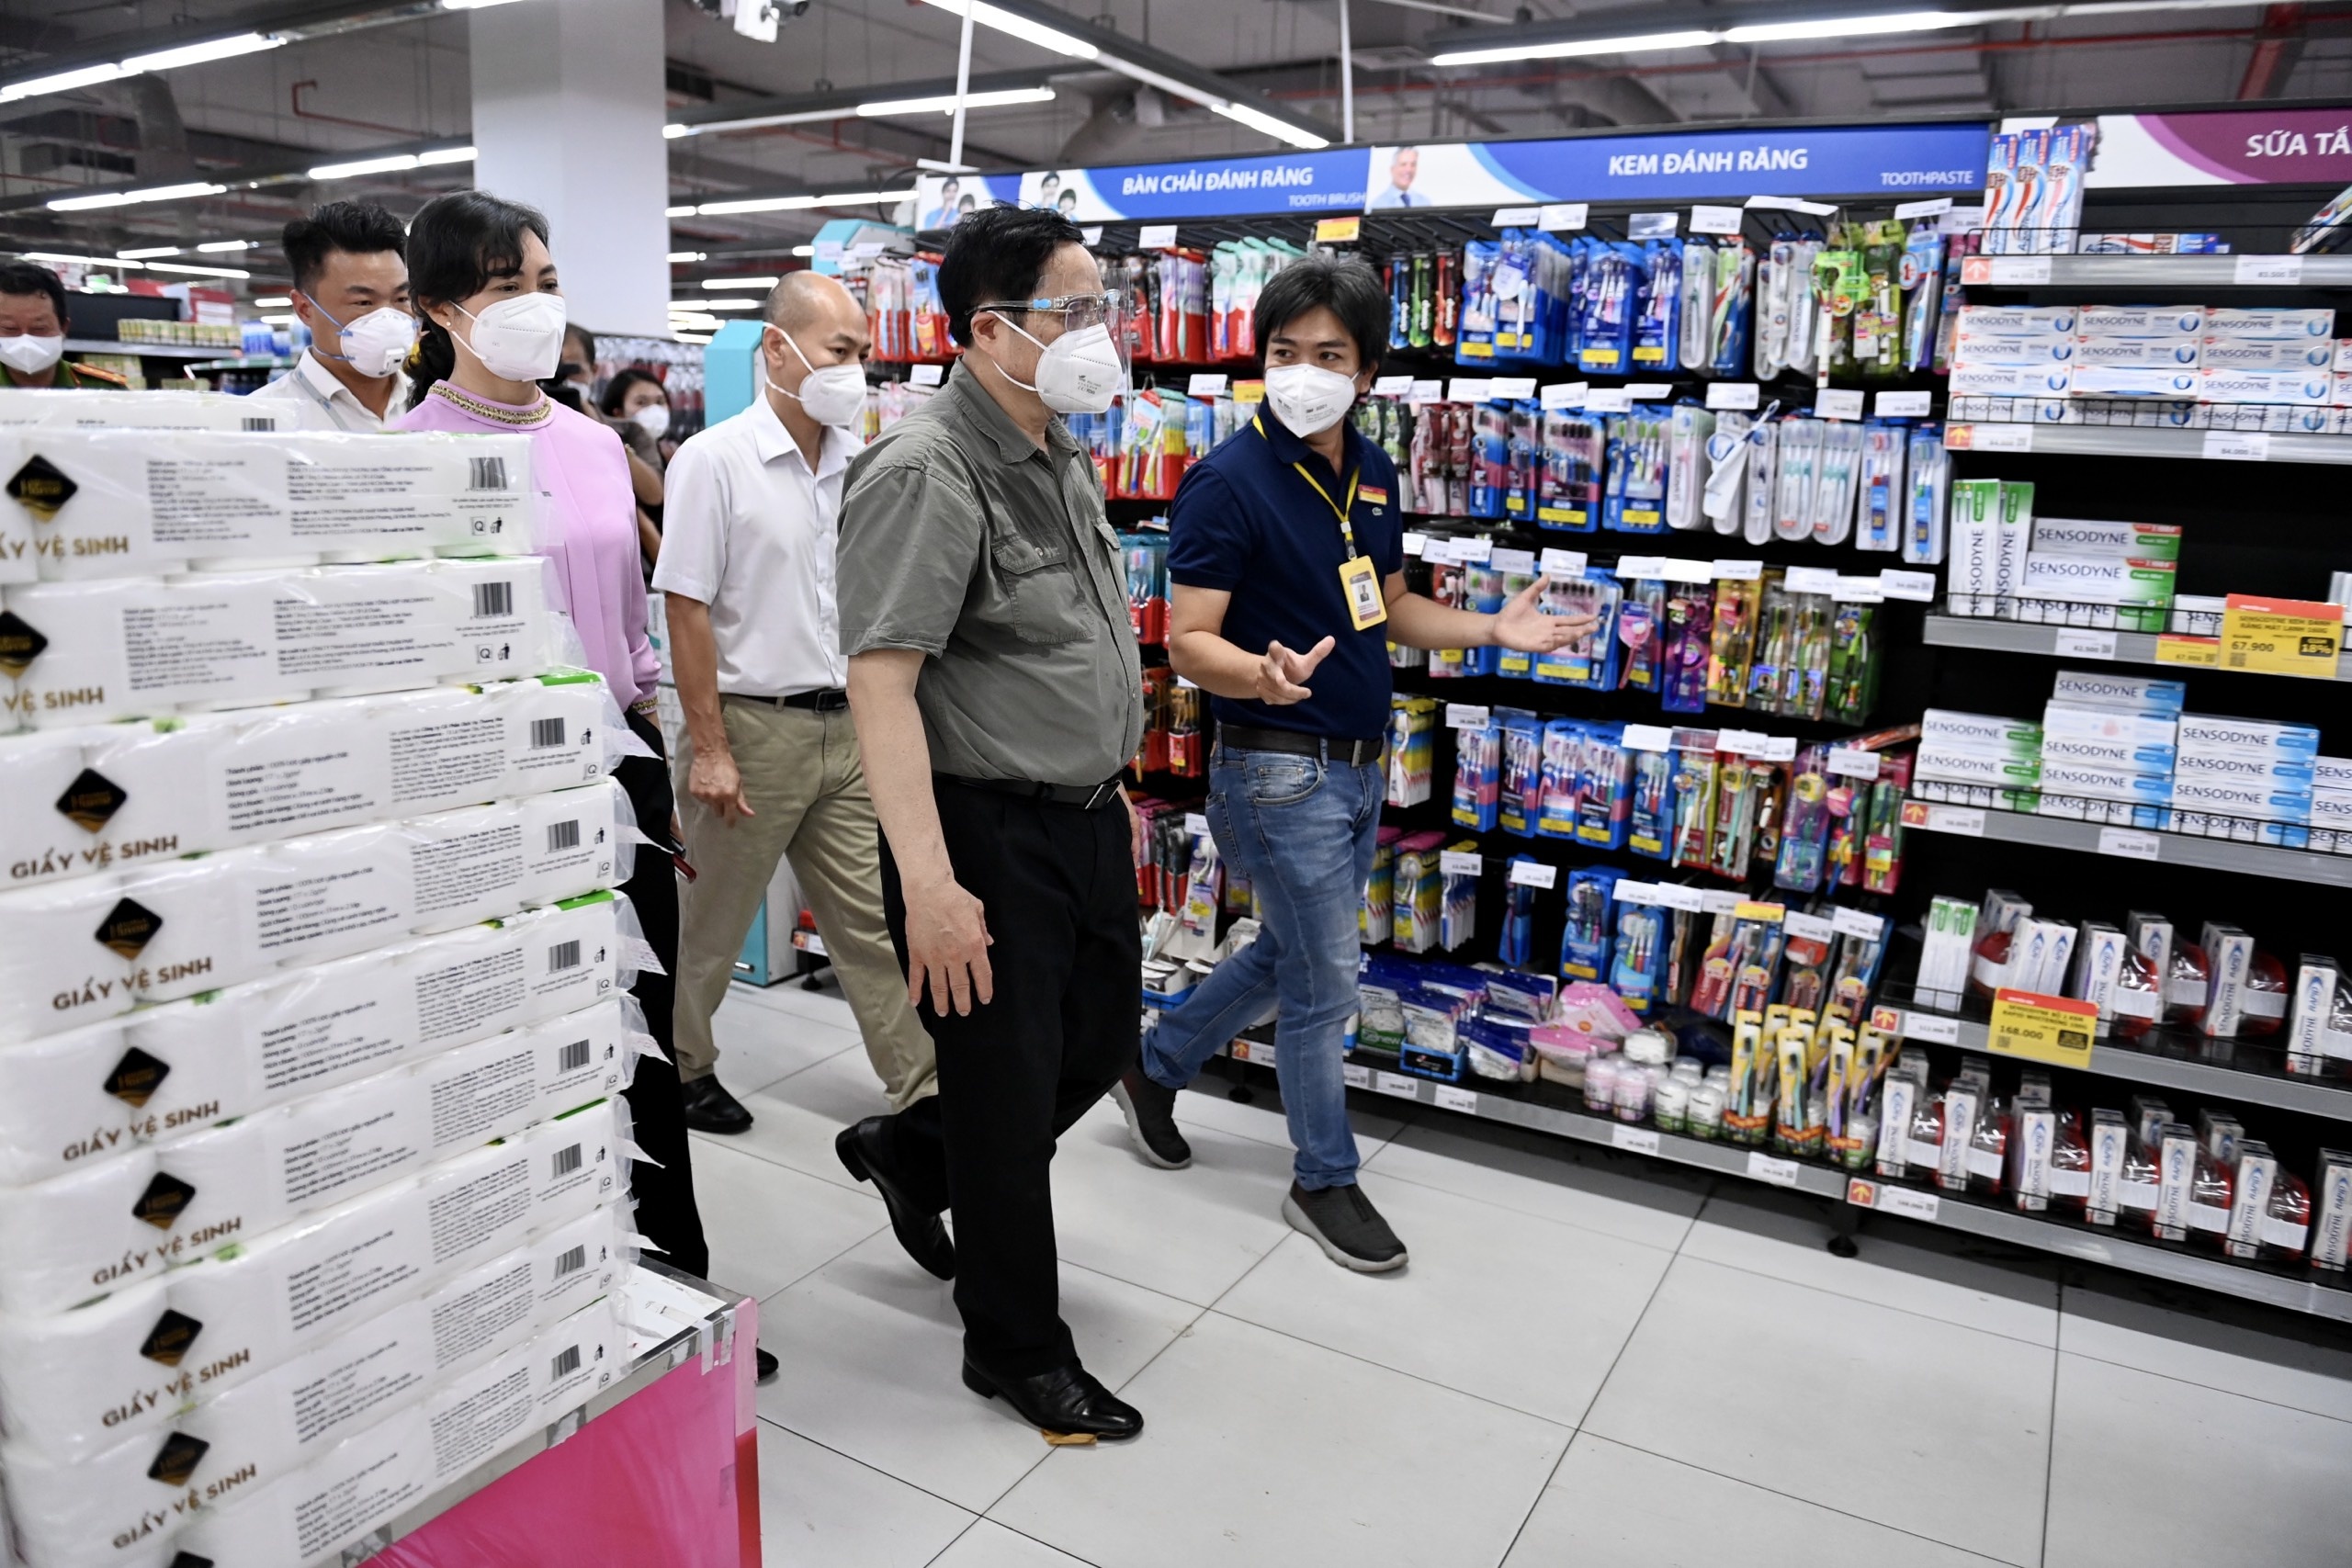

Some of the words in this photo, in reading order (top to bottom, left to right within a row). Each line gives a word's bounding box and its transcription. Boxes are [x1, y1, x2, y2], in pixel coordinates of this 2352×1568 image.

[2245, 130, 2308, 157] SỮA
[2313, 125, 2352, 155] TẮ
[1609, 155, 1655, 176] KEM
[1662, 149, 1733, 175] ĐÁNH
[1737, 146, 1808, 171] RĂNG
[1122, 174, 1158, 196] BÀN
[1160, 169, 1203, 194] CHẢI
[1204, 168, 1258, 191] ĐÁNH
[1261, 165, 1314, 187] RĂNG
[1880, 171, 1973, 186] TOOTHPASTE
[1288, 194, 1327, 208] TOOTH
[1328, 192, 1365, 206] BRUSH
[1965, 316, 2024, 325] SENSODYNE
[2084, 316, 2146, 325] SENSODYNE
[2207, 321, 2272, 330] SENSODYNE
[1962, 344, 2020, 354] SENSODYNE
[2081, 347, 2143, 356] SENSODYNE
[2207, 349, 2272, 358] SENSODYNE
[1957, 374, 2017, 384] SENSODYNE
[2205, 380, 2270, 390] SENSODYNE
[2037, 526, 2129, 545] SENSODYNE
[36, 534, 65, 563] VỆ
[73, 536, 129, 557] SINH
[1970, 529, 1984, 614] SENSODYNE
[1996, 530, 2016, 615] SENSODYNE
[2029, 561, 2122, 580] SENSODYNE
[2018, 598, 2110, 615] SENSODYNE
[2232, 641, 2274, 652] 67.900
[2058, 680, 2139, 698] SENSODYNE
[4, 688, 36, 717] VỆ
[43, 685, 105, 710] SINH
[1926, 720, 2000, 739] SENSODYNE
[2183, 728, 2269, 746] SENSODYNE
[2046, 740, 2128, 761] SENSODYNE
[1920, 753, 1996, 773] SENSODYNE
[2179, 756, 2266, 774] SENSODYNE
[2045, 768, 2127, 787] SENSODYNE
[2177, 784, 2263, 804] SENSODYNE
[2043, 795, 2124, 816] SENSODYNE
[2174, 812, 2259, 832] SENSODYNE
[10, 846, 74, 879] GIẤY
[82, 841, 113, 869] VỆ
[120, 835, 178, 859] SINH
[52, 976, 112, 1010] GIẤY
[122, 968, 150, 993] VỆ
[157, 956, 212, 985] SINH
[2000, 1025, 2044, 1040] 168.000
[62, 1127, 120, 1161] GIẤY
[130, 1114, 157, 1138] VỆ
[164, 1100, 220, 1129] SINH
[2325, 1213, 2344, 1261] ENSODYNE
[93, 1250, 148, 1285] GIẤY
[156, 1235, 183, 1257] VỆ
[190, 1216, 242, 1247] SINH
[101, 1390, 158, 1427] GIẤY
[165, 1371, 193, 1396] VỆ
[199, 1348, 250, 1383] SINH
[207, 1463, 257, 1500] SINH
